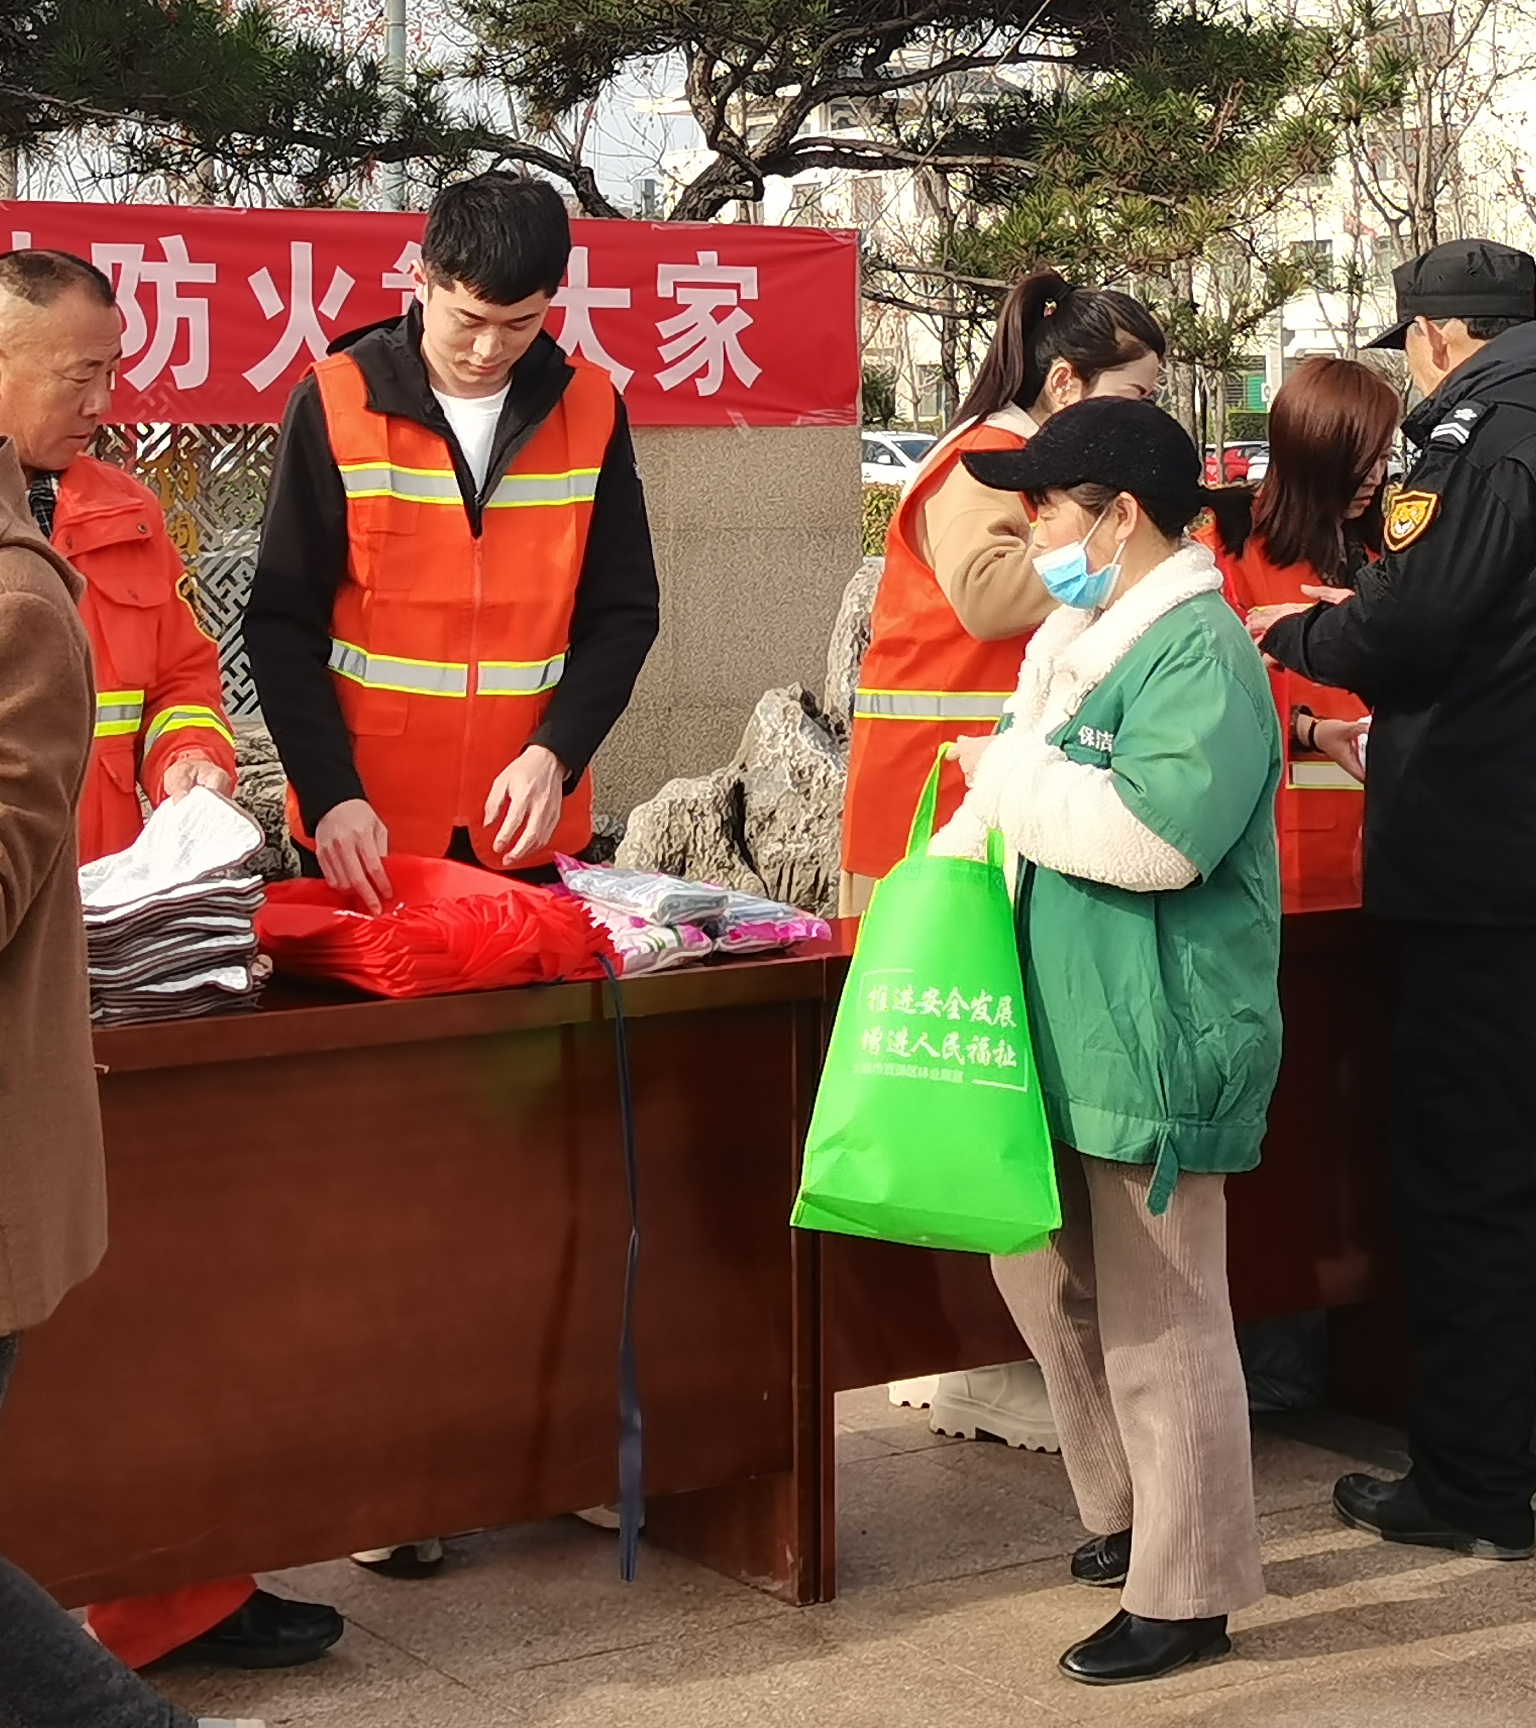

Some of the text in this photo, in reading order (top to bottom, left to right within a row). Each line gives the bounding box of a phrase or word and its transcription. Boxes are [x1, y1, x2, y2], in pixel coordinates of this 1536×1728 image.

[1078, 725, 1114, 752] 保洁
[867, 983, 1017, 1028] 推进安全发展
[860, 1024, 1017, 1069] 增进人民福祉
